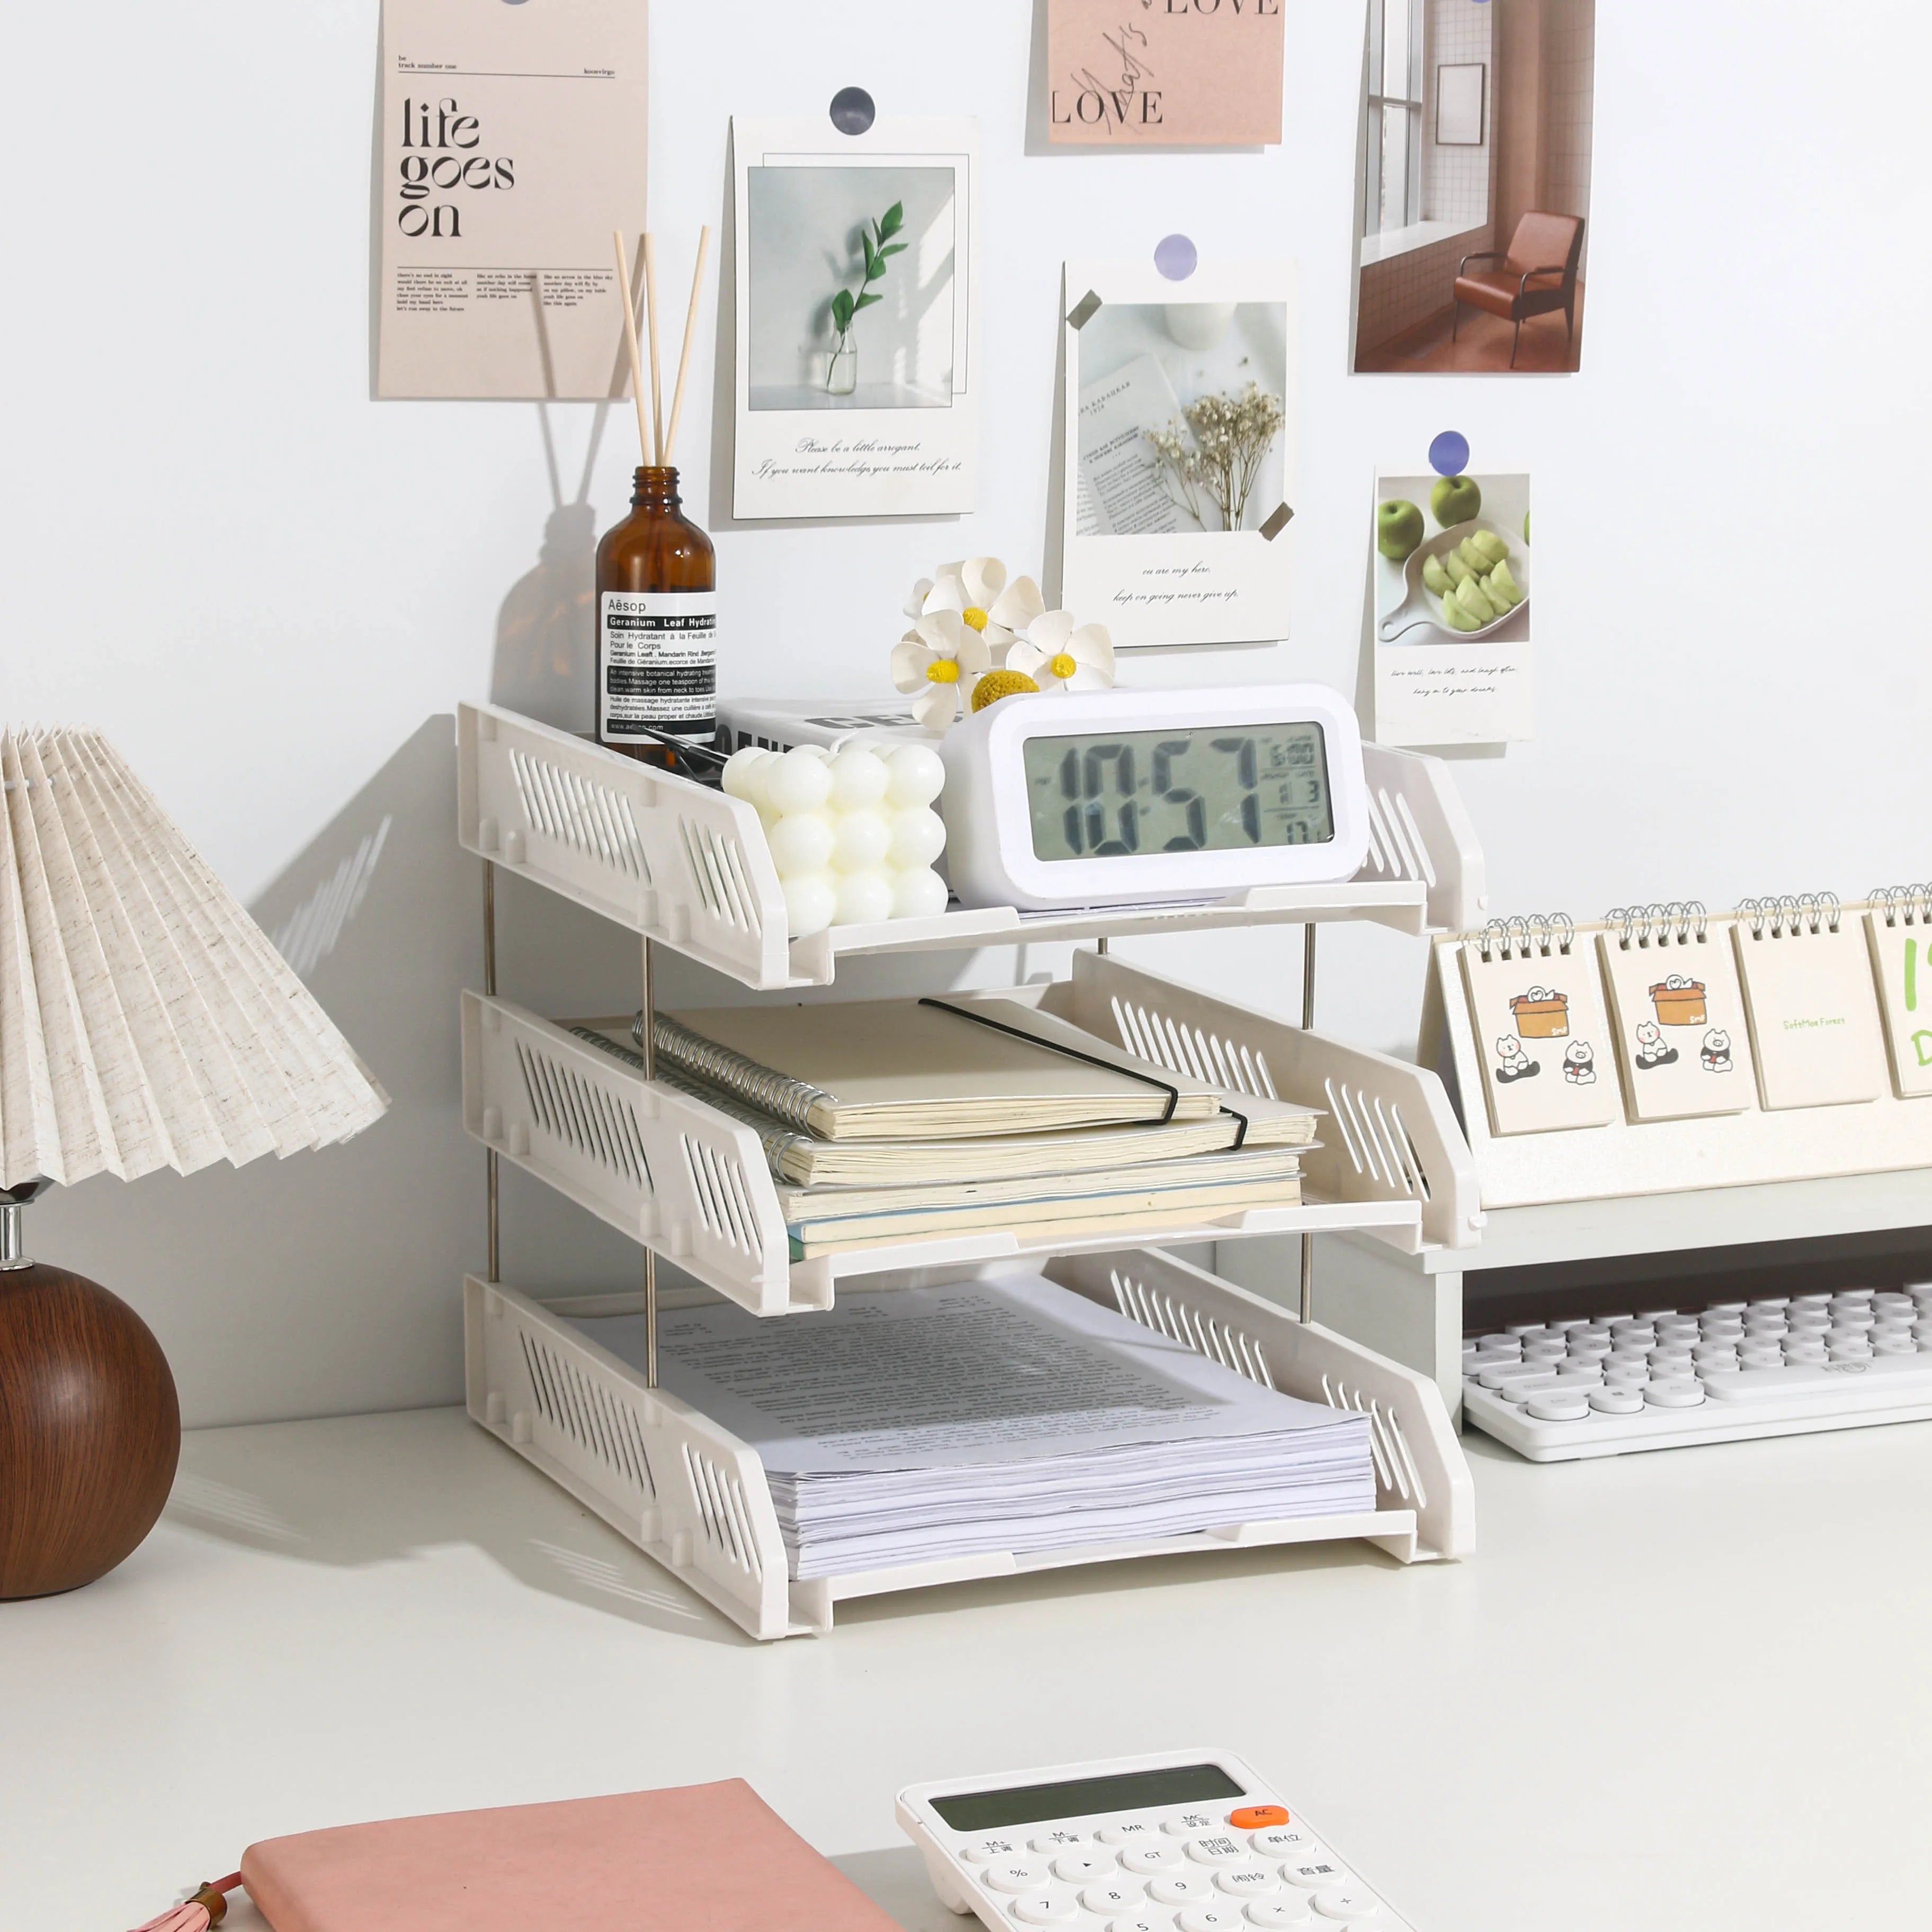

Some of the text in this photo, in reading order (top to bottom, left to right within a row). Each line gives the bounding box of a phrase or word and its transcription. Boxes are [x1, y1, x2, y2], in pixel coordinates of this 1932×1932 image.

[1052, 91, 1162, 123] LOVE
[401, 98, 480, 149] life
[400, 156, 515, 200] goes
[398, 204, 462, 237] on
[795, 437, 827, 453] Please
[831, 440, 841, 452] be
[853, 440, 875, 452] little
[772, 467, 789, 478] you
[793, 466, 820, 474] want
[873, 466, 889, 477] you
[893, 462, 918, 472] must
[933, 458, 949, 476] for
[1172, 568, 1188, 578] my
[1113, 589, 1133, 605] keep
[1146, 593, 1175, 604] going
[610, 617, 656, 627] Geranium
[664, 619, 685, 627] Leaf
[628, 632, 665, 641] Hydratant
[687, 631, 706, 640] Feuille
[1122, 1824, 1145, 1832] MR
[1198, 1837, 1233, 1848] 时间
[1144, 1850, 1162, 1859] GT
[1210, 1846, 1239, 1855] 日期
[1010, 1868, 1028, 1879] %
[1175, 1882, 1187, 1891] 9
[1108, 1891, 1121, 1900] 8
[1040, 1901, 1050, 1909] 7
[1206, 1913, 1217, 1923] 6
[1137, 1923, 1149, 1932] 5
